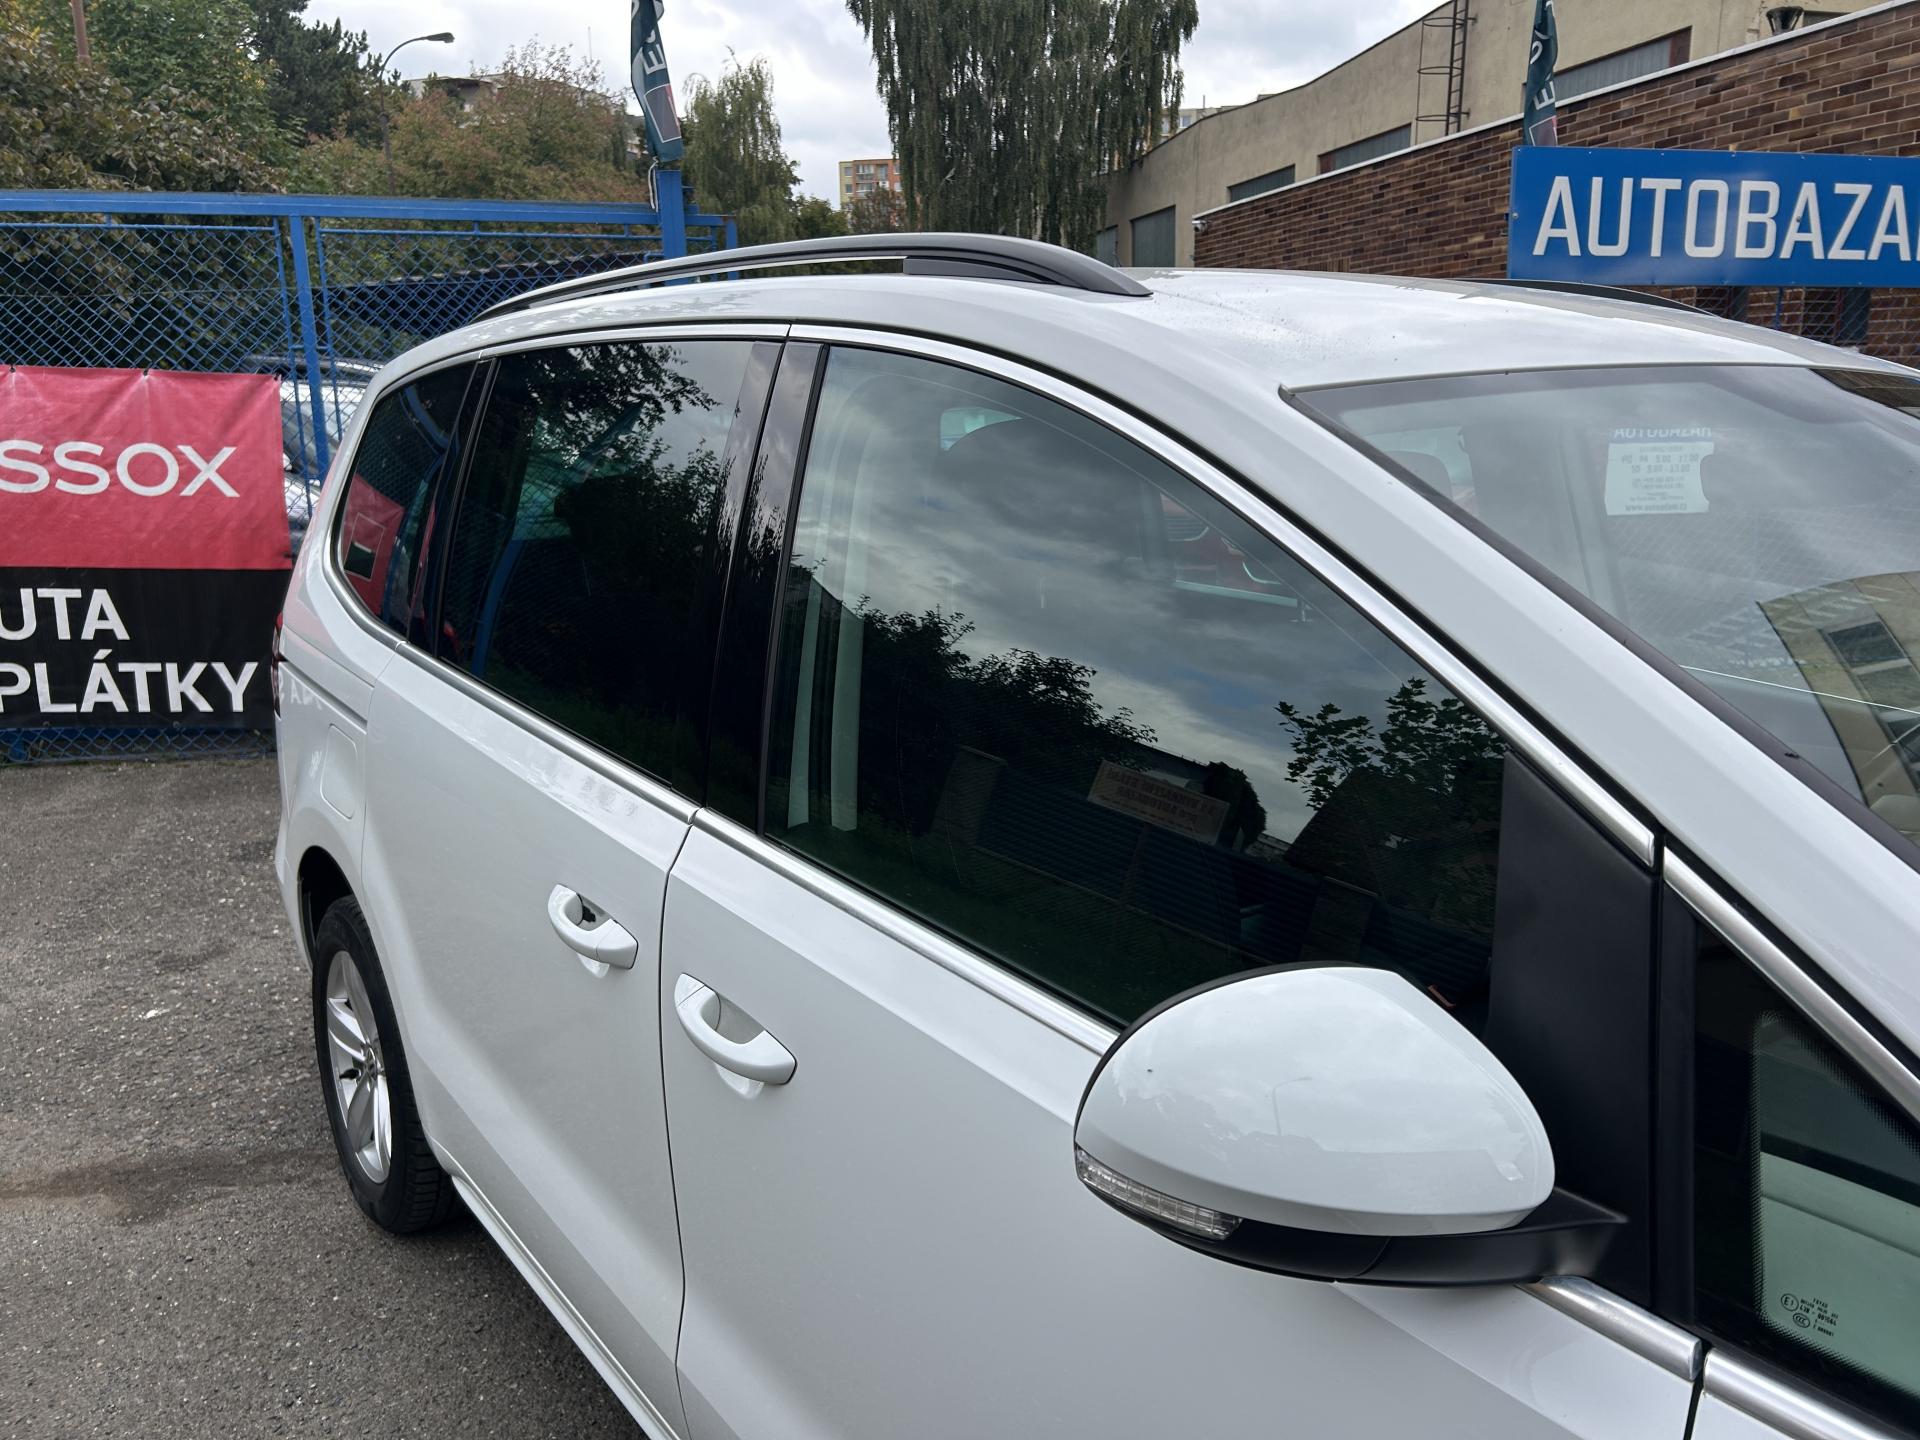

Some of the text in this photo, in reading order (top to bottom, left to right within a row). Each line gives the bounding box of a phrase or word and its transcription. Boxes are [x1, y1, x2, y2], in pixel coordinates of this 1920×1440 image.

[1532, 175, 1920, 262] AUTOBAZA
[0, 439, 240, 498] SSOX
[0, 587, 131, 641] UTA
